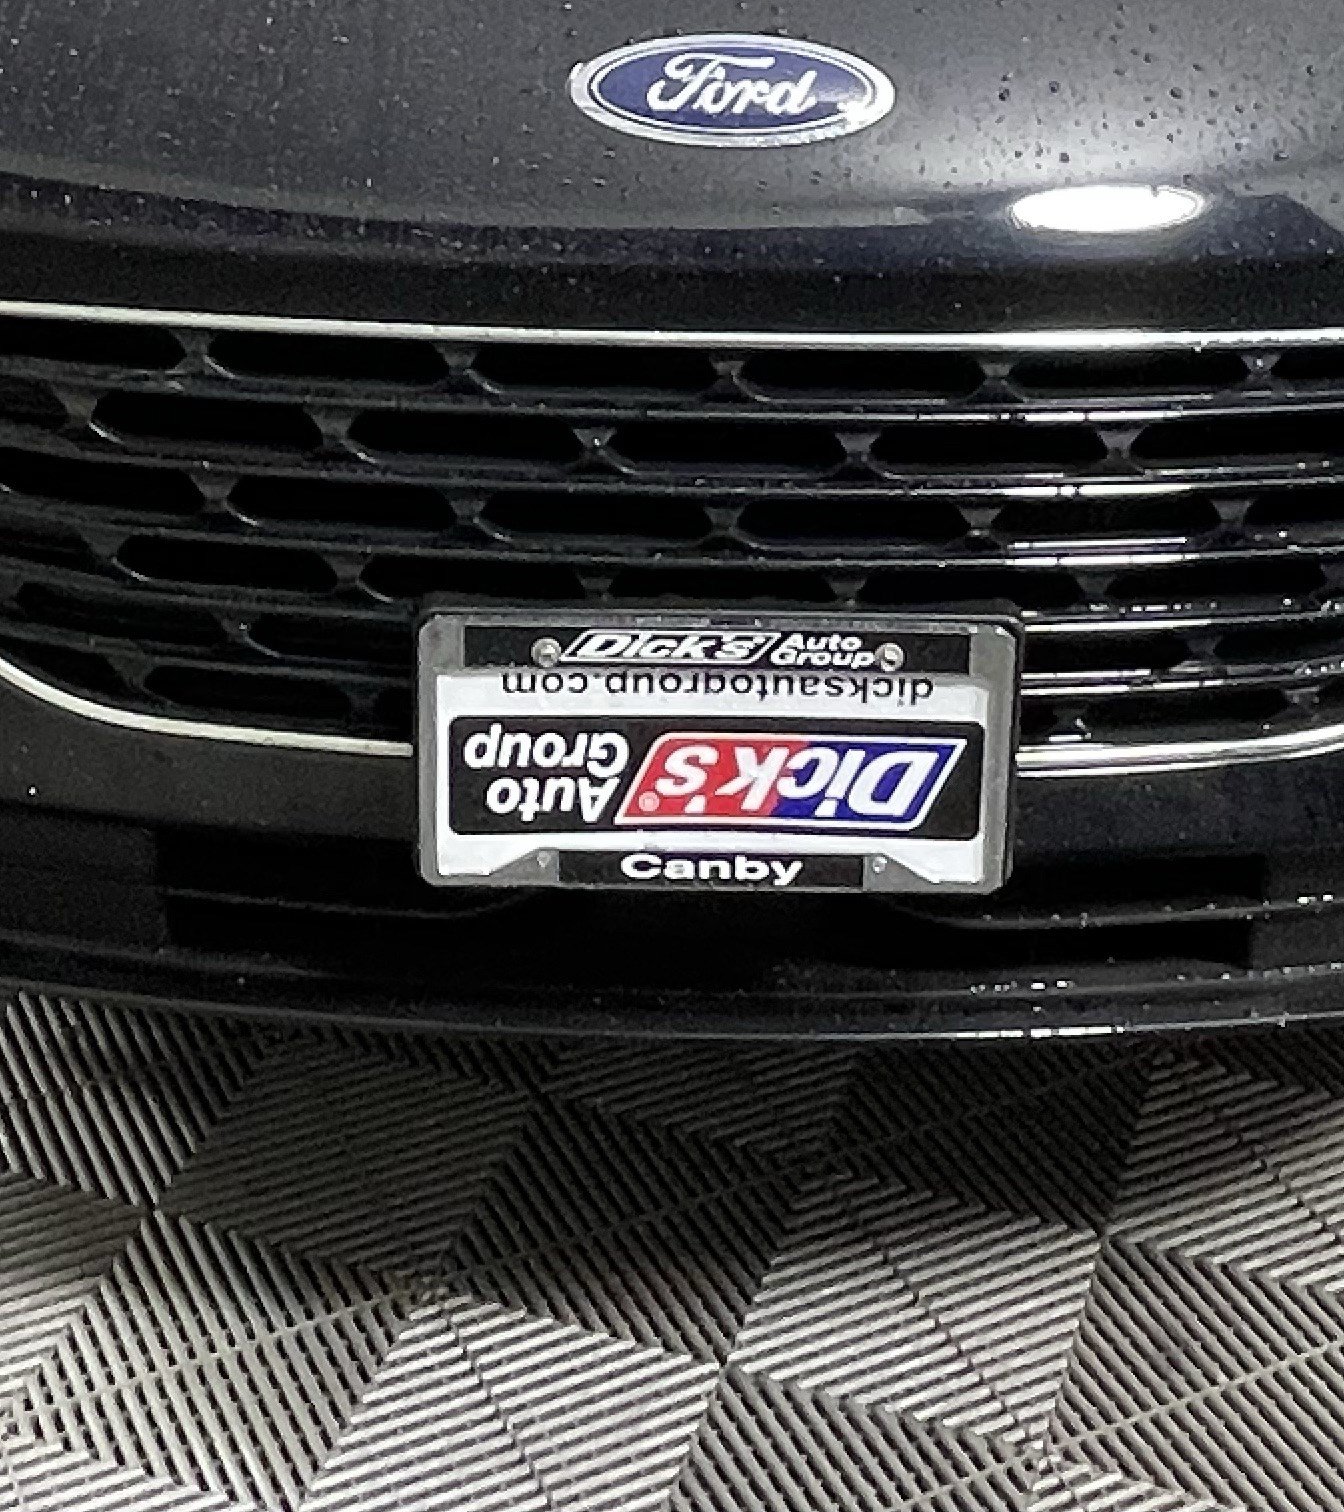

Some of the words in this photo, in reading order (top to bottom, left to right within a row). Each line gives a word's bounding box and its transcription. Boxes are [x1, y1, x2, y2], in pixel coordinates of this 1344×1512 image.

[646, 52, 818, 115] Ford
[769, 648, 876, 670] Group
[784, 632, 863, 652] Auto
[501, 672, 934, 705] dicksautogroup.com
[462, 723, 631, 779] Group
[486, 775, 622, 824] Auto
[654, 745, 941, 818] Dick's
[620, 852, 803, 885] Canby
